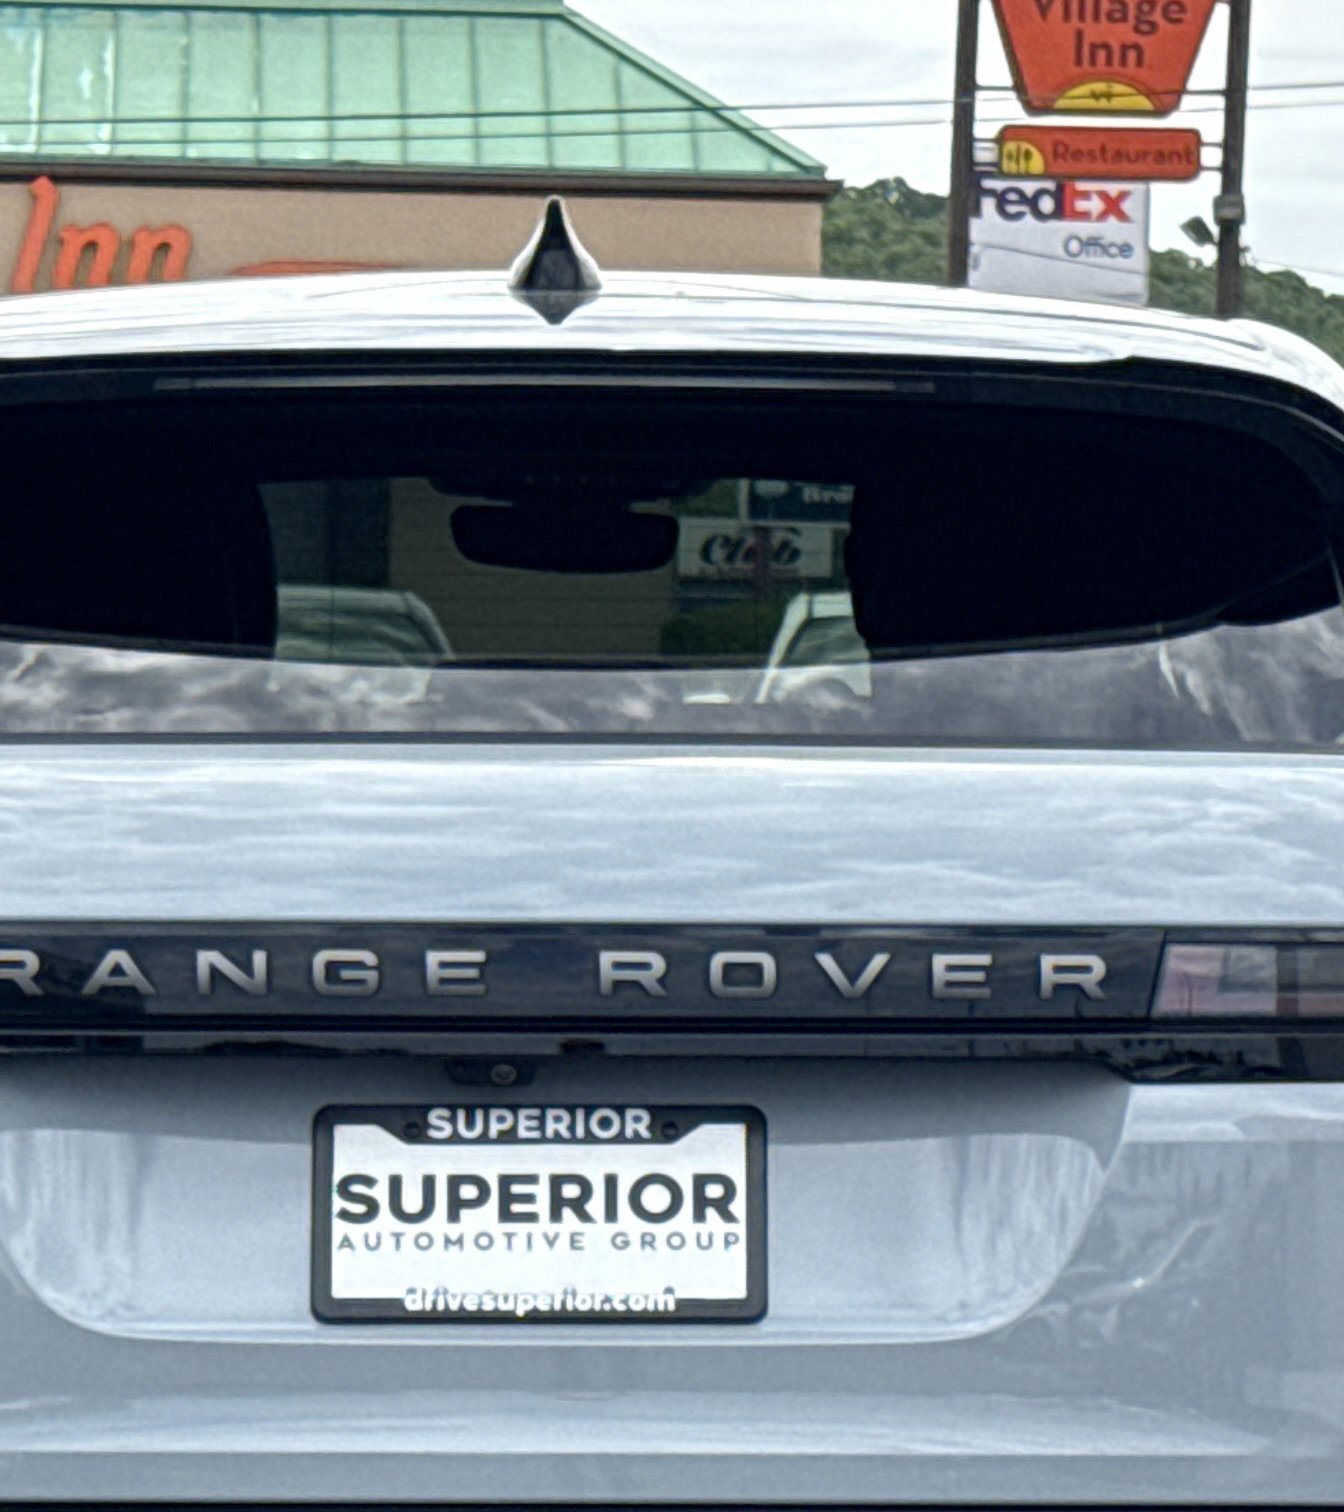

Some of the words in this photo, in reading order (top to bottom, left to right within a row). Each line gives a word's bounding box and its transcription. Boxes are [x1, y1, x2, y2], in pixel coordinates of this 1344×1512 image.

[1073, 28, 1146, 68] Inn
[1051, 141, 1195, 166] Restaurant
[11, 175, 194, 292] Inn
[1063, 233, 1134, 260] Office
[600, 951, 1109, 1001] ROVER
[425, 1107, 653, 1140] SUPERIOR
[335, 1172, 740, 1225] SUPERIOR
[337, 1231, 586, 1252] AUTOMOTIVE
[611, 1231, 741, 1252] GROUP
[403, 1286, 677, 1317] drivesuperior.com
